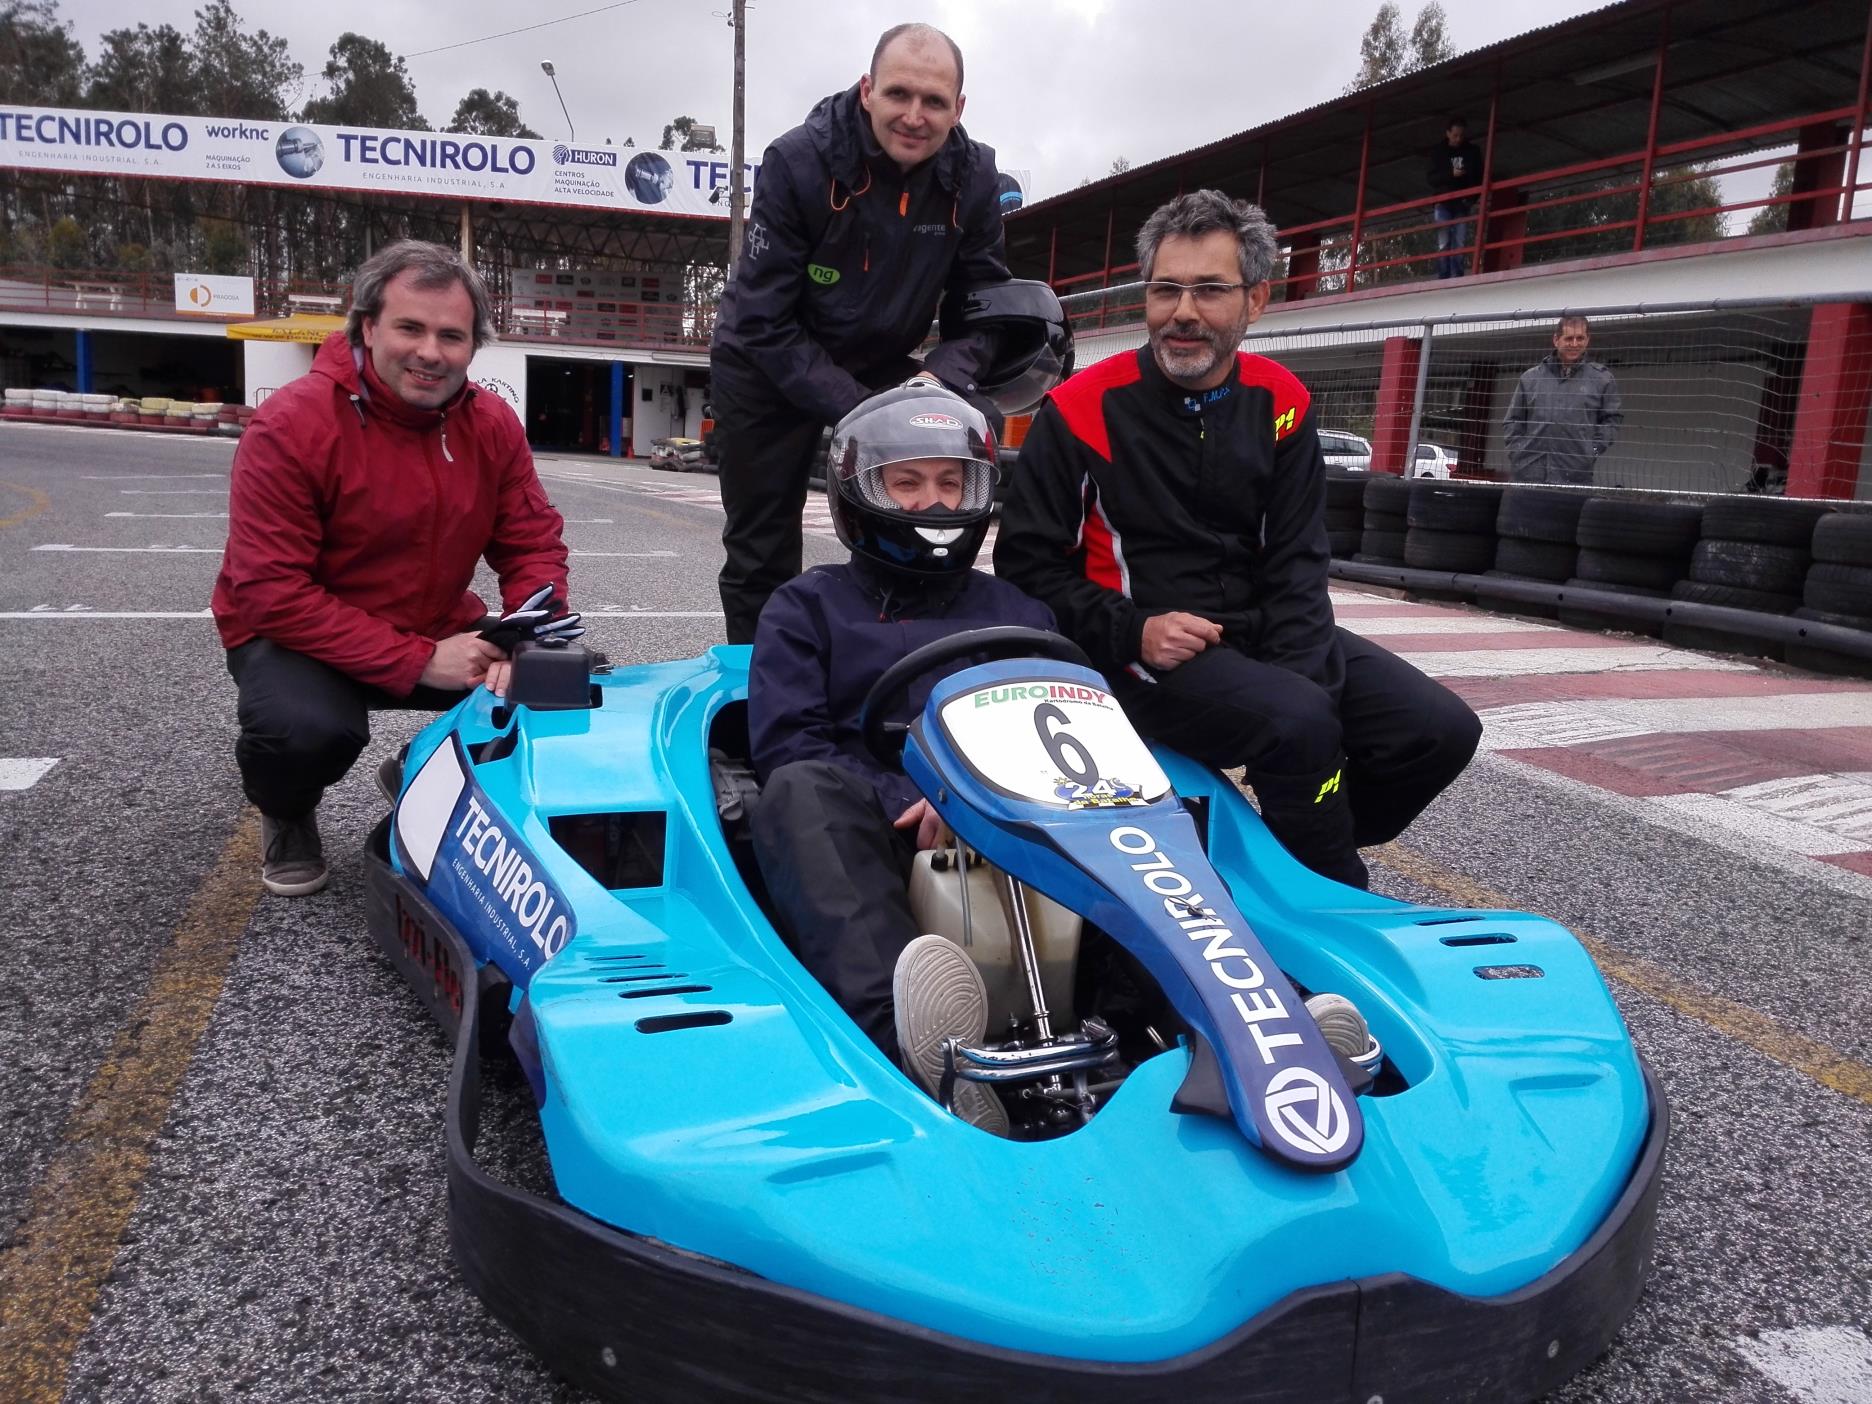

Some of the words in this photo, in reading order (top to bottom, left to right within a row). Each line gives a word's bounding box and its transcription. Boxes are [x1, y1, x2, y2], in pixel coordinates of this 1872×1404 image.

[0, 112, 189, 151] TECNIROLO
[205, 123, 270, 141] worknc
[18, 151, 78, 161] ENGENHARIA
[336, 133, 536, 175] TECNIROLO
[574, 151, 614, 165] HURON
[362, 172, 423, 182] ENGENHARIA
[554, 170, 585, 178] CENTROS
[554, 178, 600, 188] MAQUINAÇÃO
[572, 188, 615, 198] VELOCIDADE
[813, 266, 834, 282] ng
[491, 377, 520, 404] KARTING
[974, 685, 1105, 709] EUROINDY
[1033, 702, 1100, 787] 6
[455, 796, 568, 960] TECNIROLO
[451, 858, 486, 905] ENGENHARIA
[483, 902, 518, 953] INDUSTRIAL,
[1109, 825, 1305, 1066] TECNIROLO
